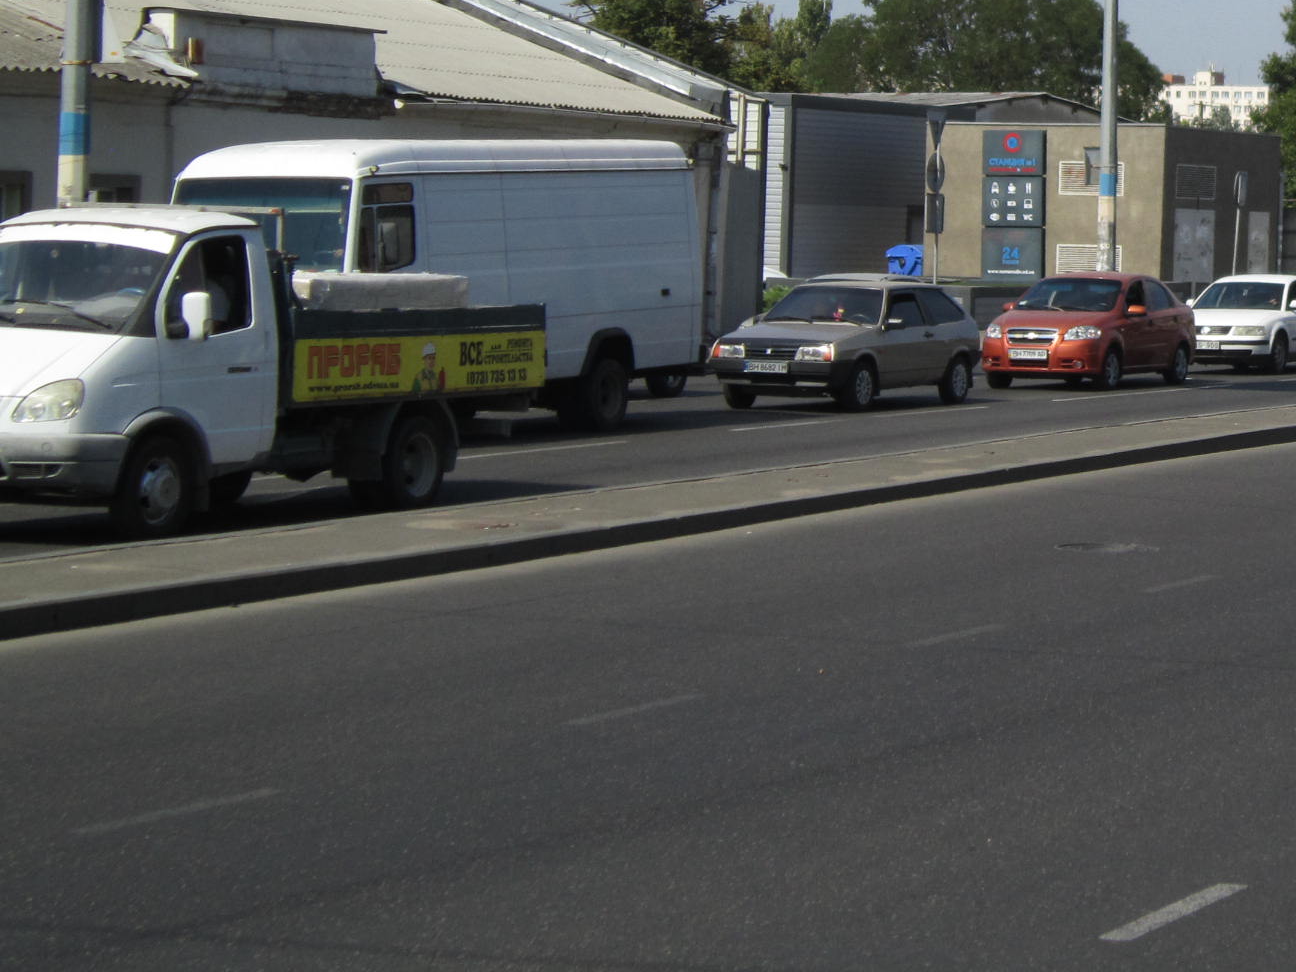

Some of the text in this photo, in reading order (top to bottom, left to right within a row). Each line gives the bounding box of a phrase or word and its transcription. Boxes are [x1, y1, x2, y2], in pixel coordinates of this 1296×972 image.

[1003, 246, 1020, 259] 24
[308, 343, 400, 379] ПРОРАБ
[459, 341, 484, 366] ВСЕ
